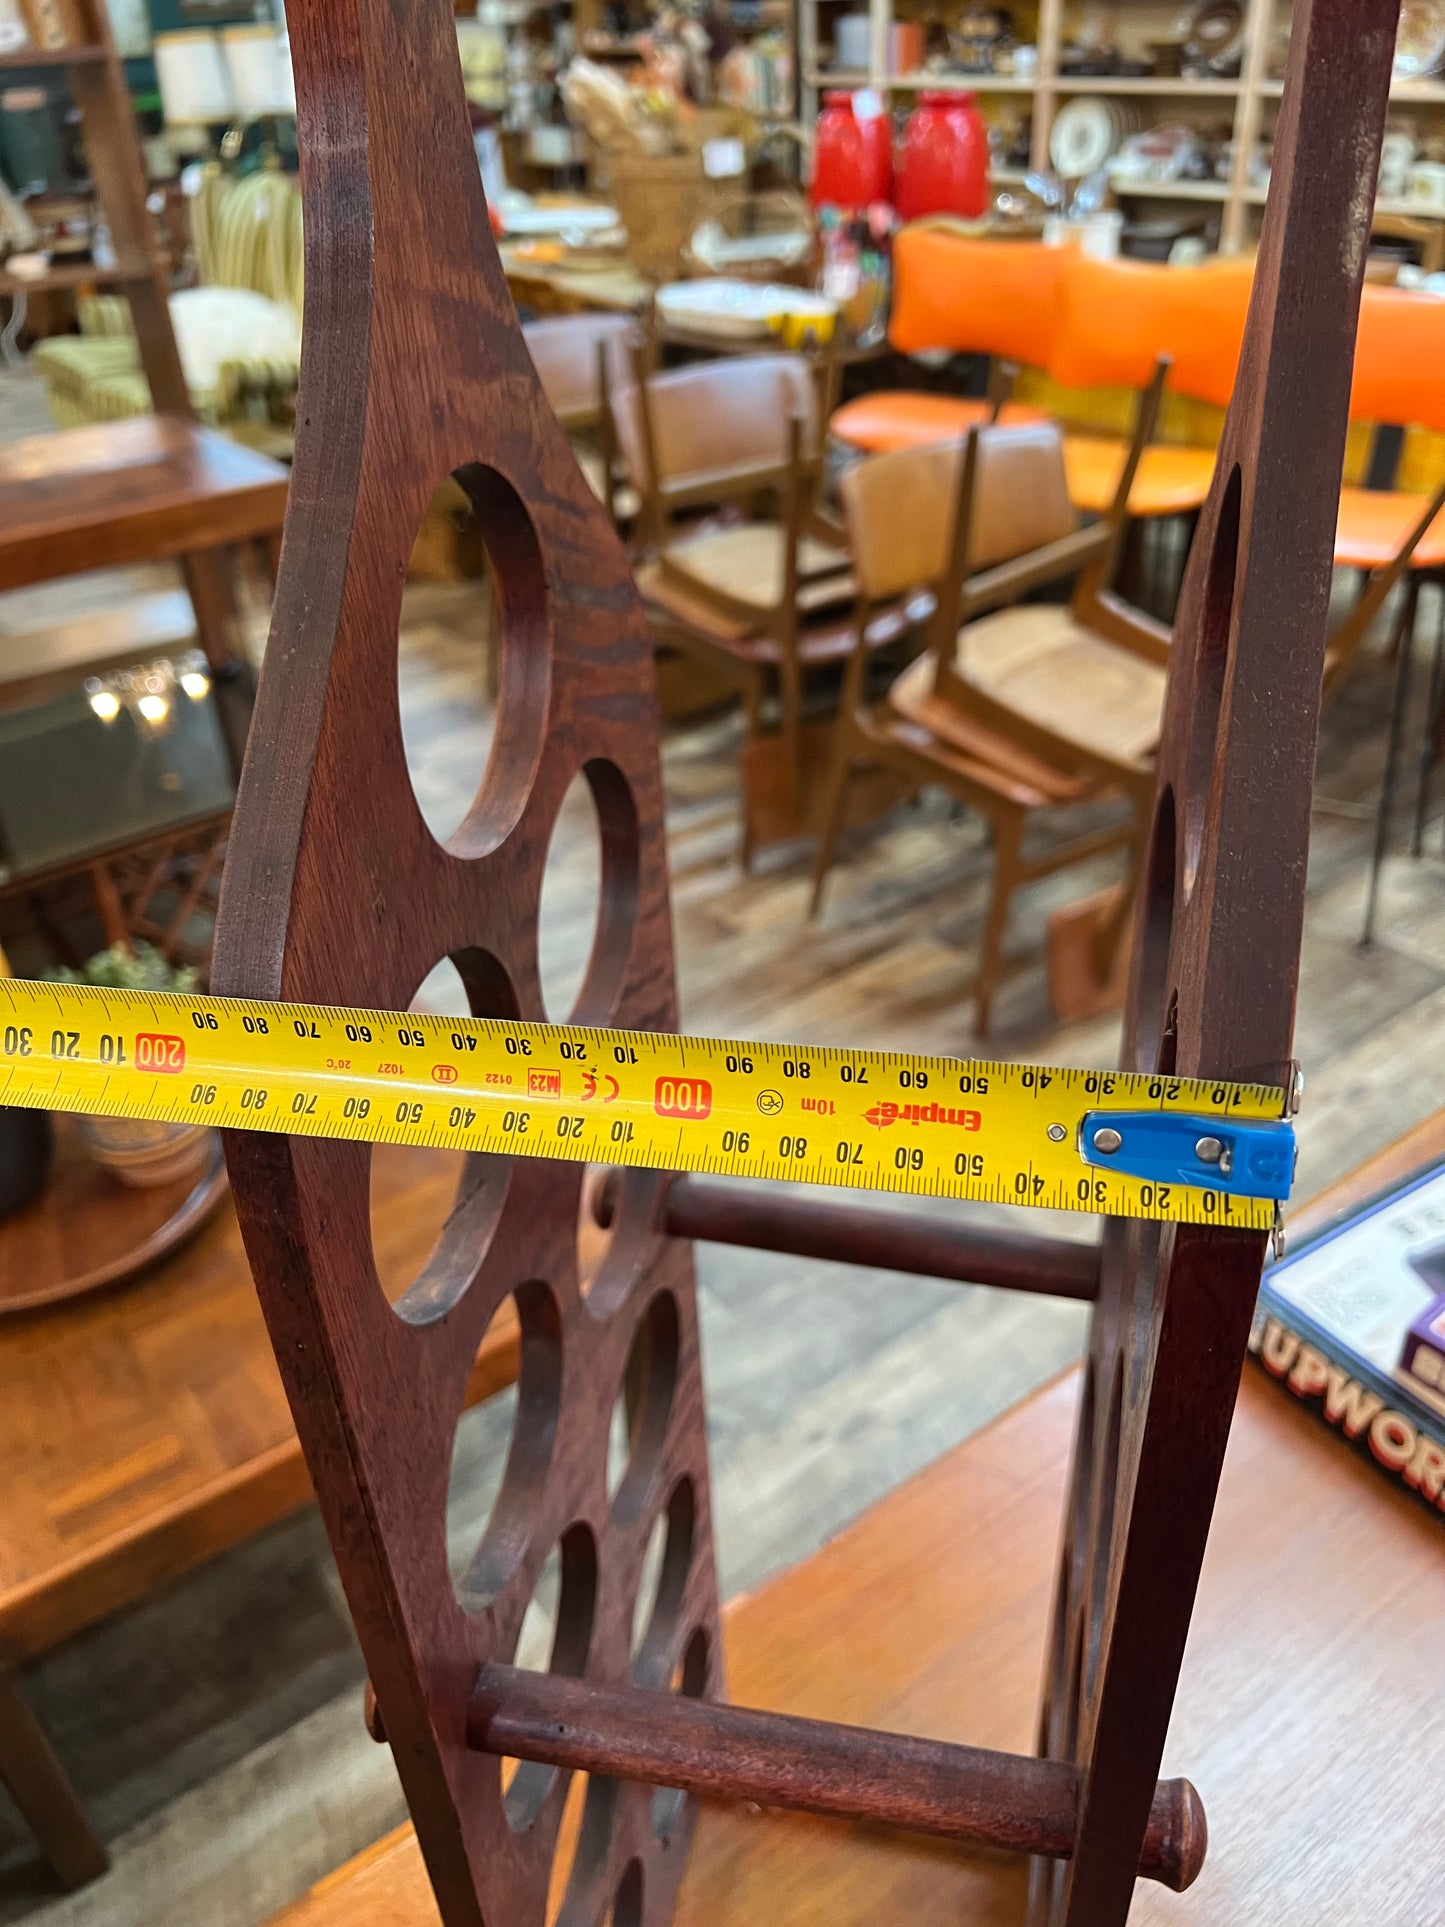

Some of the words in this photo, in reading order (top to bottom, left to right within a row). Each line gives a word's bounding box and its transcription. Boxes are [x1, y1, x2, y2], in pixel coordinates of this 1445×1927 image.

[192, 1012, 219, 1030] 90
[242, 1015, 269, 1034] 80
[294, 1020, 321, 1038] 70
[4, 1026, 33, 1056] 30
[345, 1024, 372, 1042] 60
[398, 1029, 425, 1046] 50
[451, 1033, 478, 1051] 40
[51, 1030, 80, 1059] 20
[100, 1034, 126, 1064] 10
[139, 1039, 180, 1067] 200
[505, 1037, 533, 1055] 30
[559, 1042, 587, 1060] 20
[614, 1045, 638, 1063] 10
[378, 1063, 404, 1074] 1027
[725, 1056, 754, 1074] 90
[782, 1060, 811, 1078] 80
[840, 1065, 868, 1083] 70
[529, 1072, 559, 1093] M23
[899, 1070, 928, 1089] 60
[959, 1075, 989, 1094] 50
[1021, 1072, 1052, 1089] 40
[1085, 1077, 1116, 1095] 30
[190, 1084, 217, 1105] 90
[240, 1088, 267, 1110] 80
[659, 1082, 707, 1113] 100
[1149, 1082, 1181, 1100] 20
[1212, 1088, 1243, 1106] 10
[292, 1093, 318, 1114] 70
[343, 1098, 371, 1119] 60
[396, 1102, 424, 1123] 50
[801, 1098, 836, 1115] 10m
[449, 1106, 476, 1128] 40
[502, 1111, 531, 1133] 30
[557, 1116, 585, 1138] 20
[877, 1102, 981, 1132] Empire
[611, 1121, 634, 1142] 10
[722, 1131, 750, 1153] 90
[779, 1135, 807, 1158] 80
[836, 1141, 864, 1165] 70
[895, 1147, 923, 1171] 60
[954, 1152, 984, 1177] 50
[1015, 1172, 1045, 1197] 40
[1077, 1178, 1107, 1203] 30
[1140, 1186, 1171, 1209] 20
[1261, 1318, 1445, 1513] UPWOR
